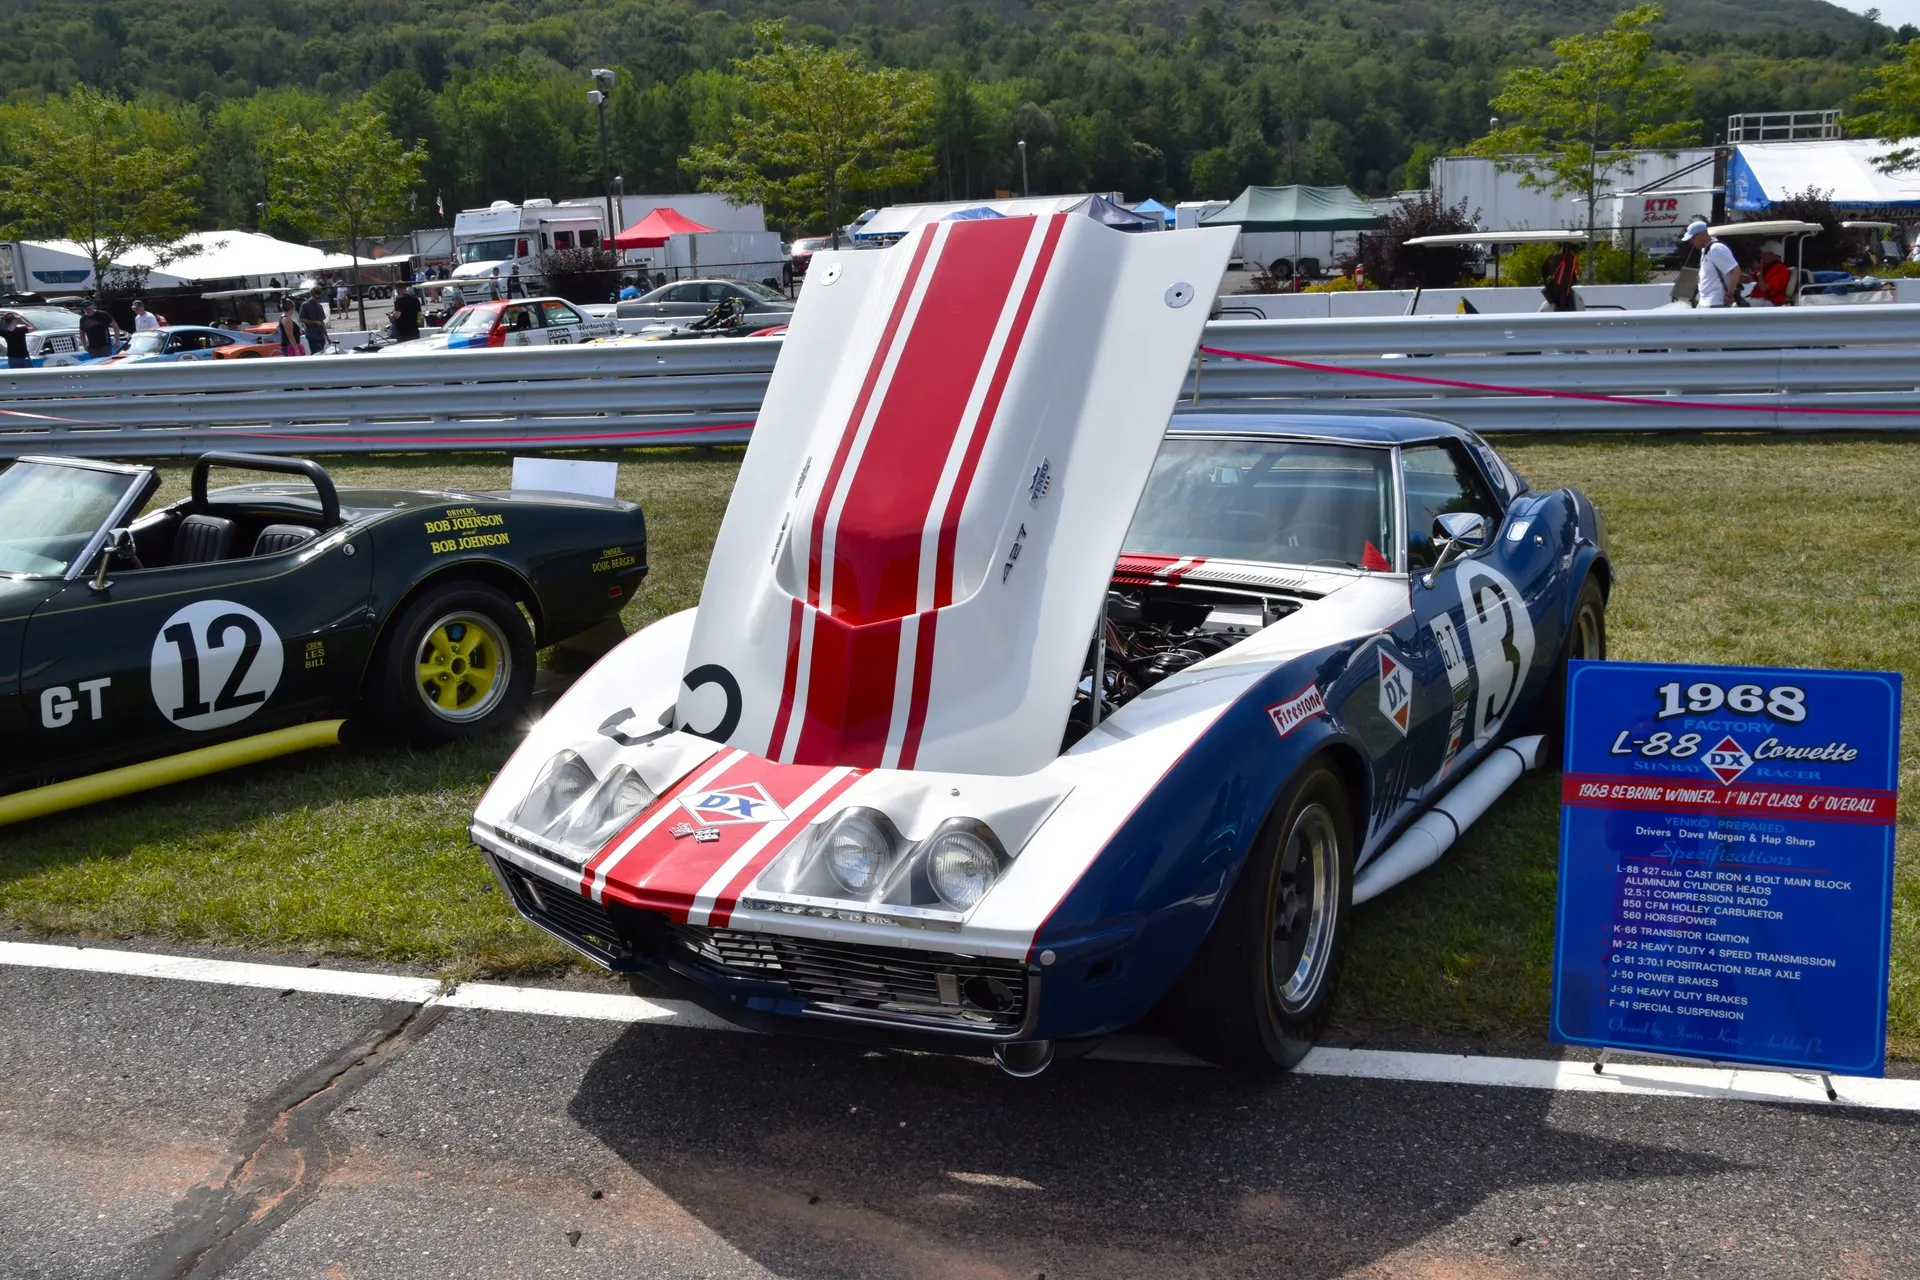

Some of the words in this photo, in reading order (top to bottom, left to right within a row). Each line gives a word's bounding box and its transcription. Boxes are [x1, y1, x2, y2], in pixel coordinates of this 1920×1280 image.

[1644, 199, 1678, 211] KTR
[1642, 212, 1678, 223] Racing
[548, 329, 570, 338] DEKRA
[1030, 463, 1050, 501] YENKO
[446, 507, 477, 517] DRIVERS
[424, 518, 451, 534] BOB
[452, 514, 504, 530] JOHNSON
[431, 538, 457, 554] BOB
[458, 532, 510, 550] JOHNSON
[1002, 522, 1028, 584] 427
[591, 559, 611, 572] DOUG
[611, 555, 636, 568] BERGEN
[305, 649, 325, 660] LES
[1436, 624, 1466, 670] G.T.
[1469, 573, 1521, 733] 3
[163, 612, 266, 721] 12
[305, 659, 326, 669] BILL
[1384, 669, 1409, 712] DX
[40, 677, 111, 729] GT
[1273, 692, 1322, 731] Firestone
[1658, 682, 1807, 722] 1968
[1684, 719, 1775, 733] FACTORY
[1612, 731, 1702, 757] L-88
[1710, 753, 1745, 767] DX
[1754, 737, 1857, 761] Corvette
[1633, 760, 1704, 773] SUNRAY
[1756, 768, 1821, 780] RACER
[695, 794, 768, 818] DX
[1579, 783, 1609, 797] 1968
[1610, 785, 1663, 800] SEBRING
[1736, 791, 1750, 806] IN
[1750, 792, 1768, 806] GT
[1767, 793, 1802, 808] CLASS
[1825, 796, 1876, 813] OVERALL
[1665, 817, 1710, 829] YENKO
[1718, 820, 1785, 833] PREPARED
[1636, 826, 1672, 837] Drivers
[1679, 829, 1704, 839] Dave
[1708, 831, 1745, 843] Morgan
[1749, 833, 1757, 843] &
[1761, 834, 1781, 845] Hap
[1785, 836, 1816, 848] Sharp
[1650, 840, 1793, 868] Specifications
[1616, 864, 1639, 874] L-88
[1642, 866, 1659, 875] 427
[1685, 869, 1713, 880] CAST
[1716, 872, 1742, 882] IRON
[1745, 874, 1751, 883] 4
[1755, 875, 1781, 885] BOLT
[1784, 877, 1811, 887] MAIN
[1814, 879, 1851, 890] BLOCK
[1625, 876, 1680, 888] ALUMINUM
[1683, 881, 1733, 892] CYLINDER
[1736, 885, 1772, 896] HEADS
[1624, 887, 1650, 897] 12.5:1
[1653, 890, 1734, 904] COMPRESSION
[1737, 896, 1768, 907] RATIO
[1623, 899, 1641, 908] 850
[1645, 900, 1669, 910] CFM
[1671, 903, 1711, 914] HOLLEY
[1713, 906, 1784, 920] CARBURETOR
[1623, 910, 1641, 920] 560
[1645, 912, 1717, 926] HORSEPOWER
[1613, 924, 1637, 934] K-66
[1640, 926, 1702, 940] TRANSISTOR
[1705, 932, 1750, 944] IGNITION
[1612, 940, 1638, 950] M-22
[1641, 942, 1674, 953] HEAVY
[1677, 945, 1705, 956] DUTY
[1709, 948, 1715, 956] 4
[1719, 949, 1752, 960] SPEED
[1755, 952, 1836, 967] TRANSMISSION
[1612, 954, 1634, 964] G-81
[1666, 959, 1741, 974] POSITRACTION
[1744, 966, 1771, 977] REAR
[1775, 970, 1801, 980] AXLE
[1611, 969, 1634, 980] J-50
[1637, 972, 1674, 983] POWER
[1678, 975, 1719, 988] BRAKES
[1610, 984, 1633, 994] J-56
[1636, 987, 1670, 998] HEAVY
[1674, 990, 1702, 1001] DUTY
[1706, 993, 1748, 1006] BRAKES
[1609, 999, 1629, 1009] F-41
[1632, 1001, 1674, 1014] SPECIAL
[1677, 1006, 1744, 1020] SUSPENSION
